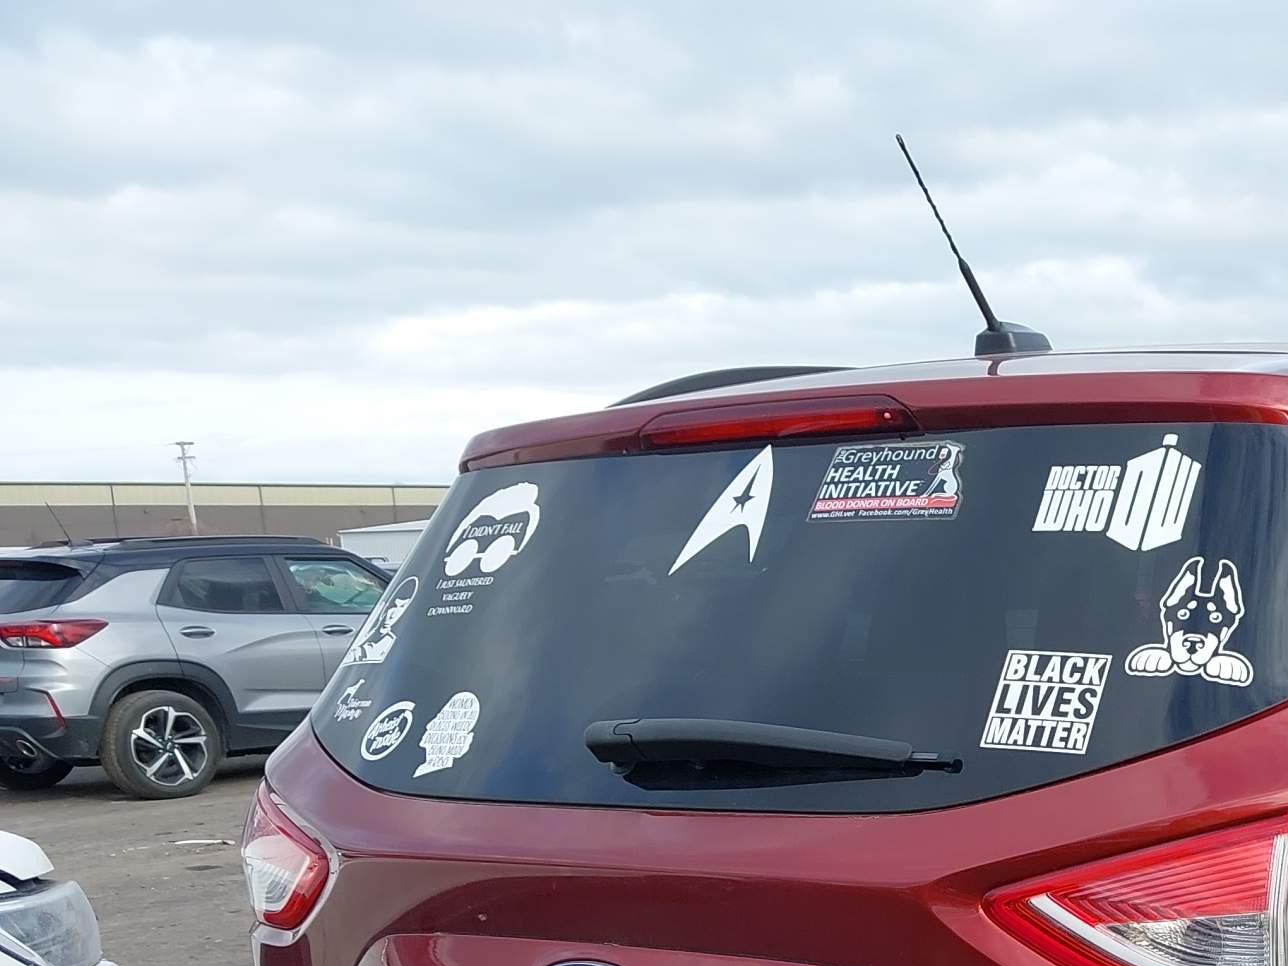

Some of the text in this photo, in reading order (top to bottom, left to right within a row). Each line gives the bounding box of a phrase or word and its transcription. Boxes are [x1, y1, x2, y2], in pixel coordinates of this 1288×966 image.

[843, 445, 939, 464] Greyhound
[826, 464, 901, 483] HEALTH
[1044, 465, 1122, 490] DOCTOR
[819, 481, 918, 499] INITIATIVE
[815, 498, 929, 511] BLOOD DONOR ON BOARD
[1032, 489, 1115, 532] WHO
[463, 525, 471, 539] I
[501, 522, 523, 535] FALL
[1005, 653, 1107, 685] BLACK
[995, 683, 1098, 720] LIVES
[986, 717, 1088, 750] MATTER
